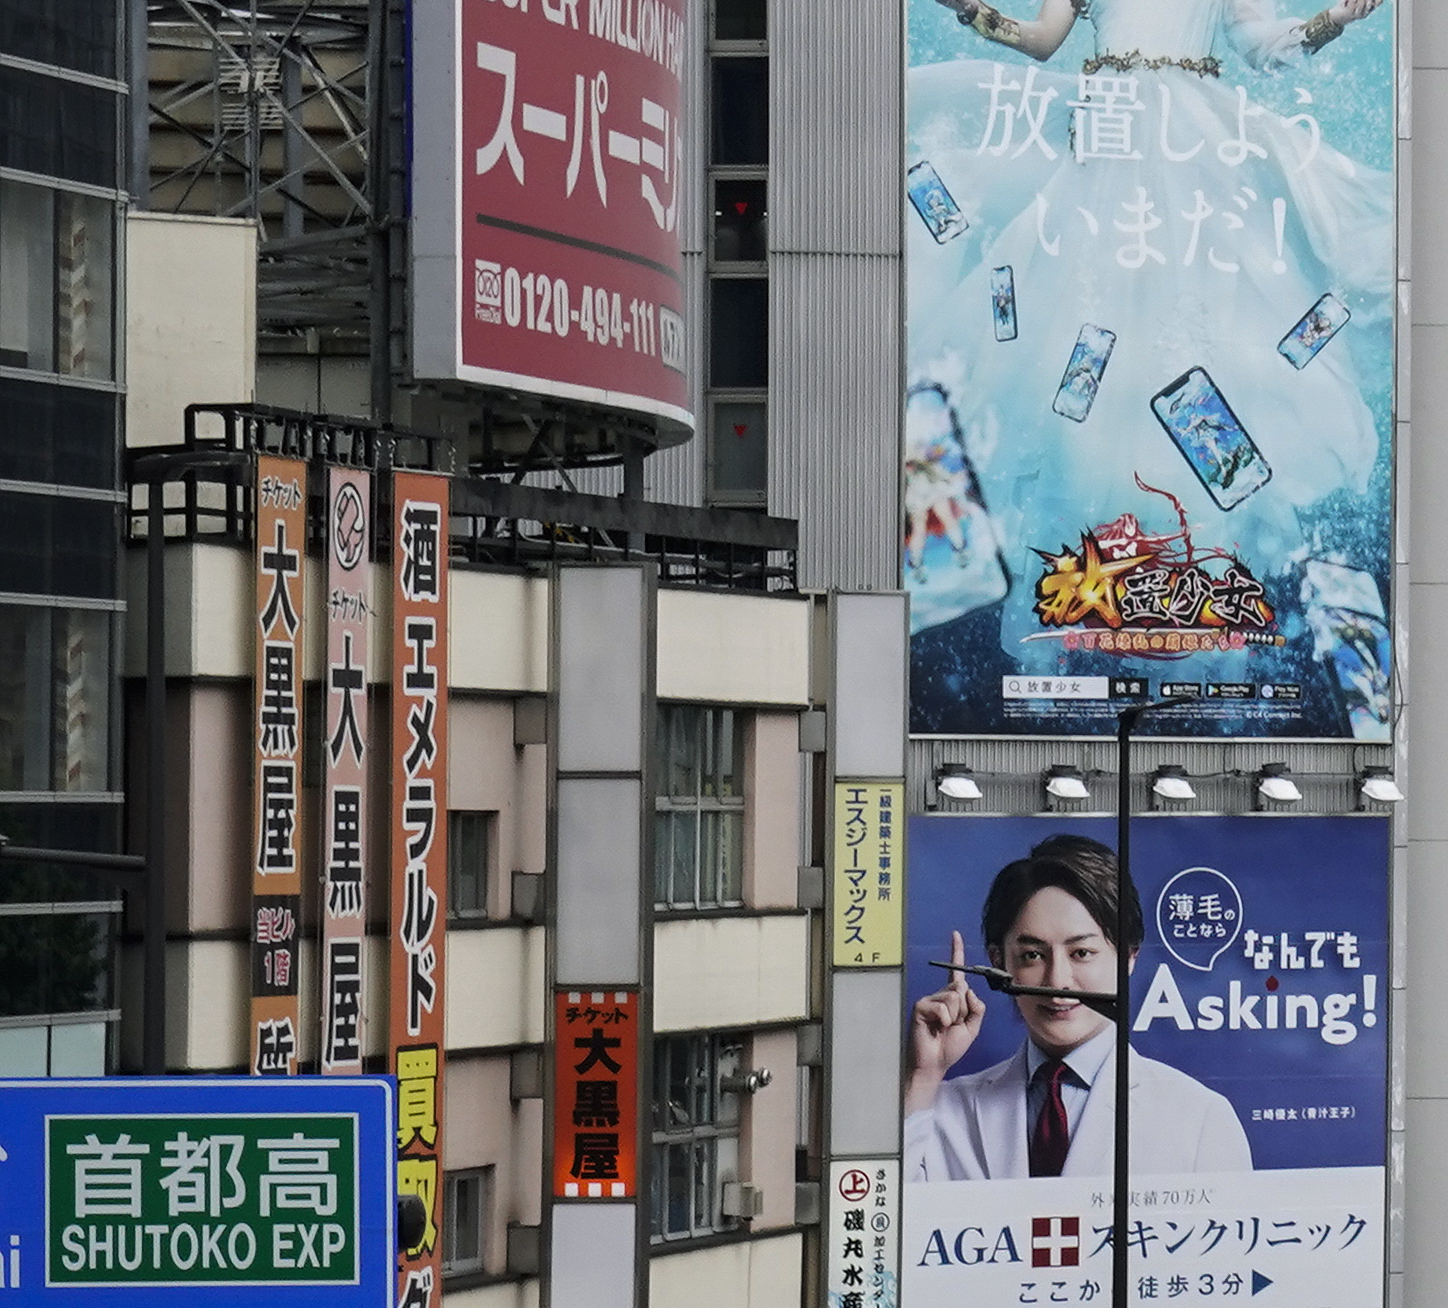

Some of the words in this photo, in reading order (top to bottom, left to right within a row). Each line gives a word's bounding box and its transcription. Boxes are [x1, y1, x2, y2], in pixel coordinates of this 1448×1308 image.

[977, 63, 1322, 171] 放置しよう
[504, 267, 656, 357] 0120-494-111
[261, 475, 302, 510] チケット
[329, 589, 370, 620] チケット
[258, 518, 300, 876] 大黒屋
[325, 630, 366, 1071] 大黒屋
[843, 788, 868, 945] エスジーマックス
[877, 788, 892, 901] 一級建築士事務所
[1168, 892, 1236, 923] 薄毛の
[1172, 922, 1228, 939] ことなら
[1243, 929, 1361, 971] なんでも
[565, 1006, 629, 1024] チケット
[1132, 962, 1378, 1046] Asking!
[570, 1028, 622, 1180] 大黒屋
[64, 1131, 342, 1220] 首都高
[1090, 1186, 1214, 1211] 外実績70万人
[60, 1222, 257, 1272] SHUTOKO
[272, 1222, 347, 1269] EXP
[917, 1225, 1024, 1268] AGA
[1087, 1212, 1368, 1261] スキンクリニック
[1018, 1272, 1246, 1305] ここか徒歩3分
